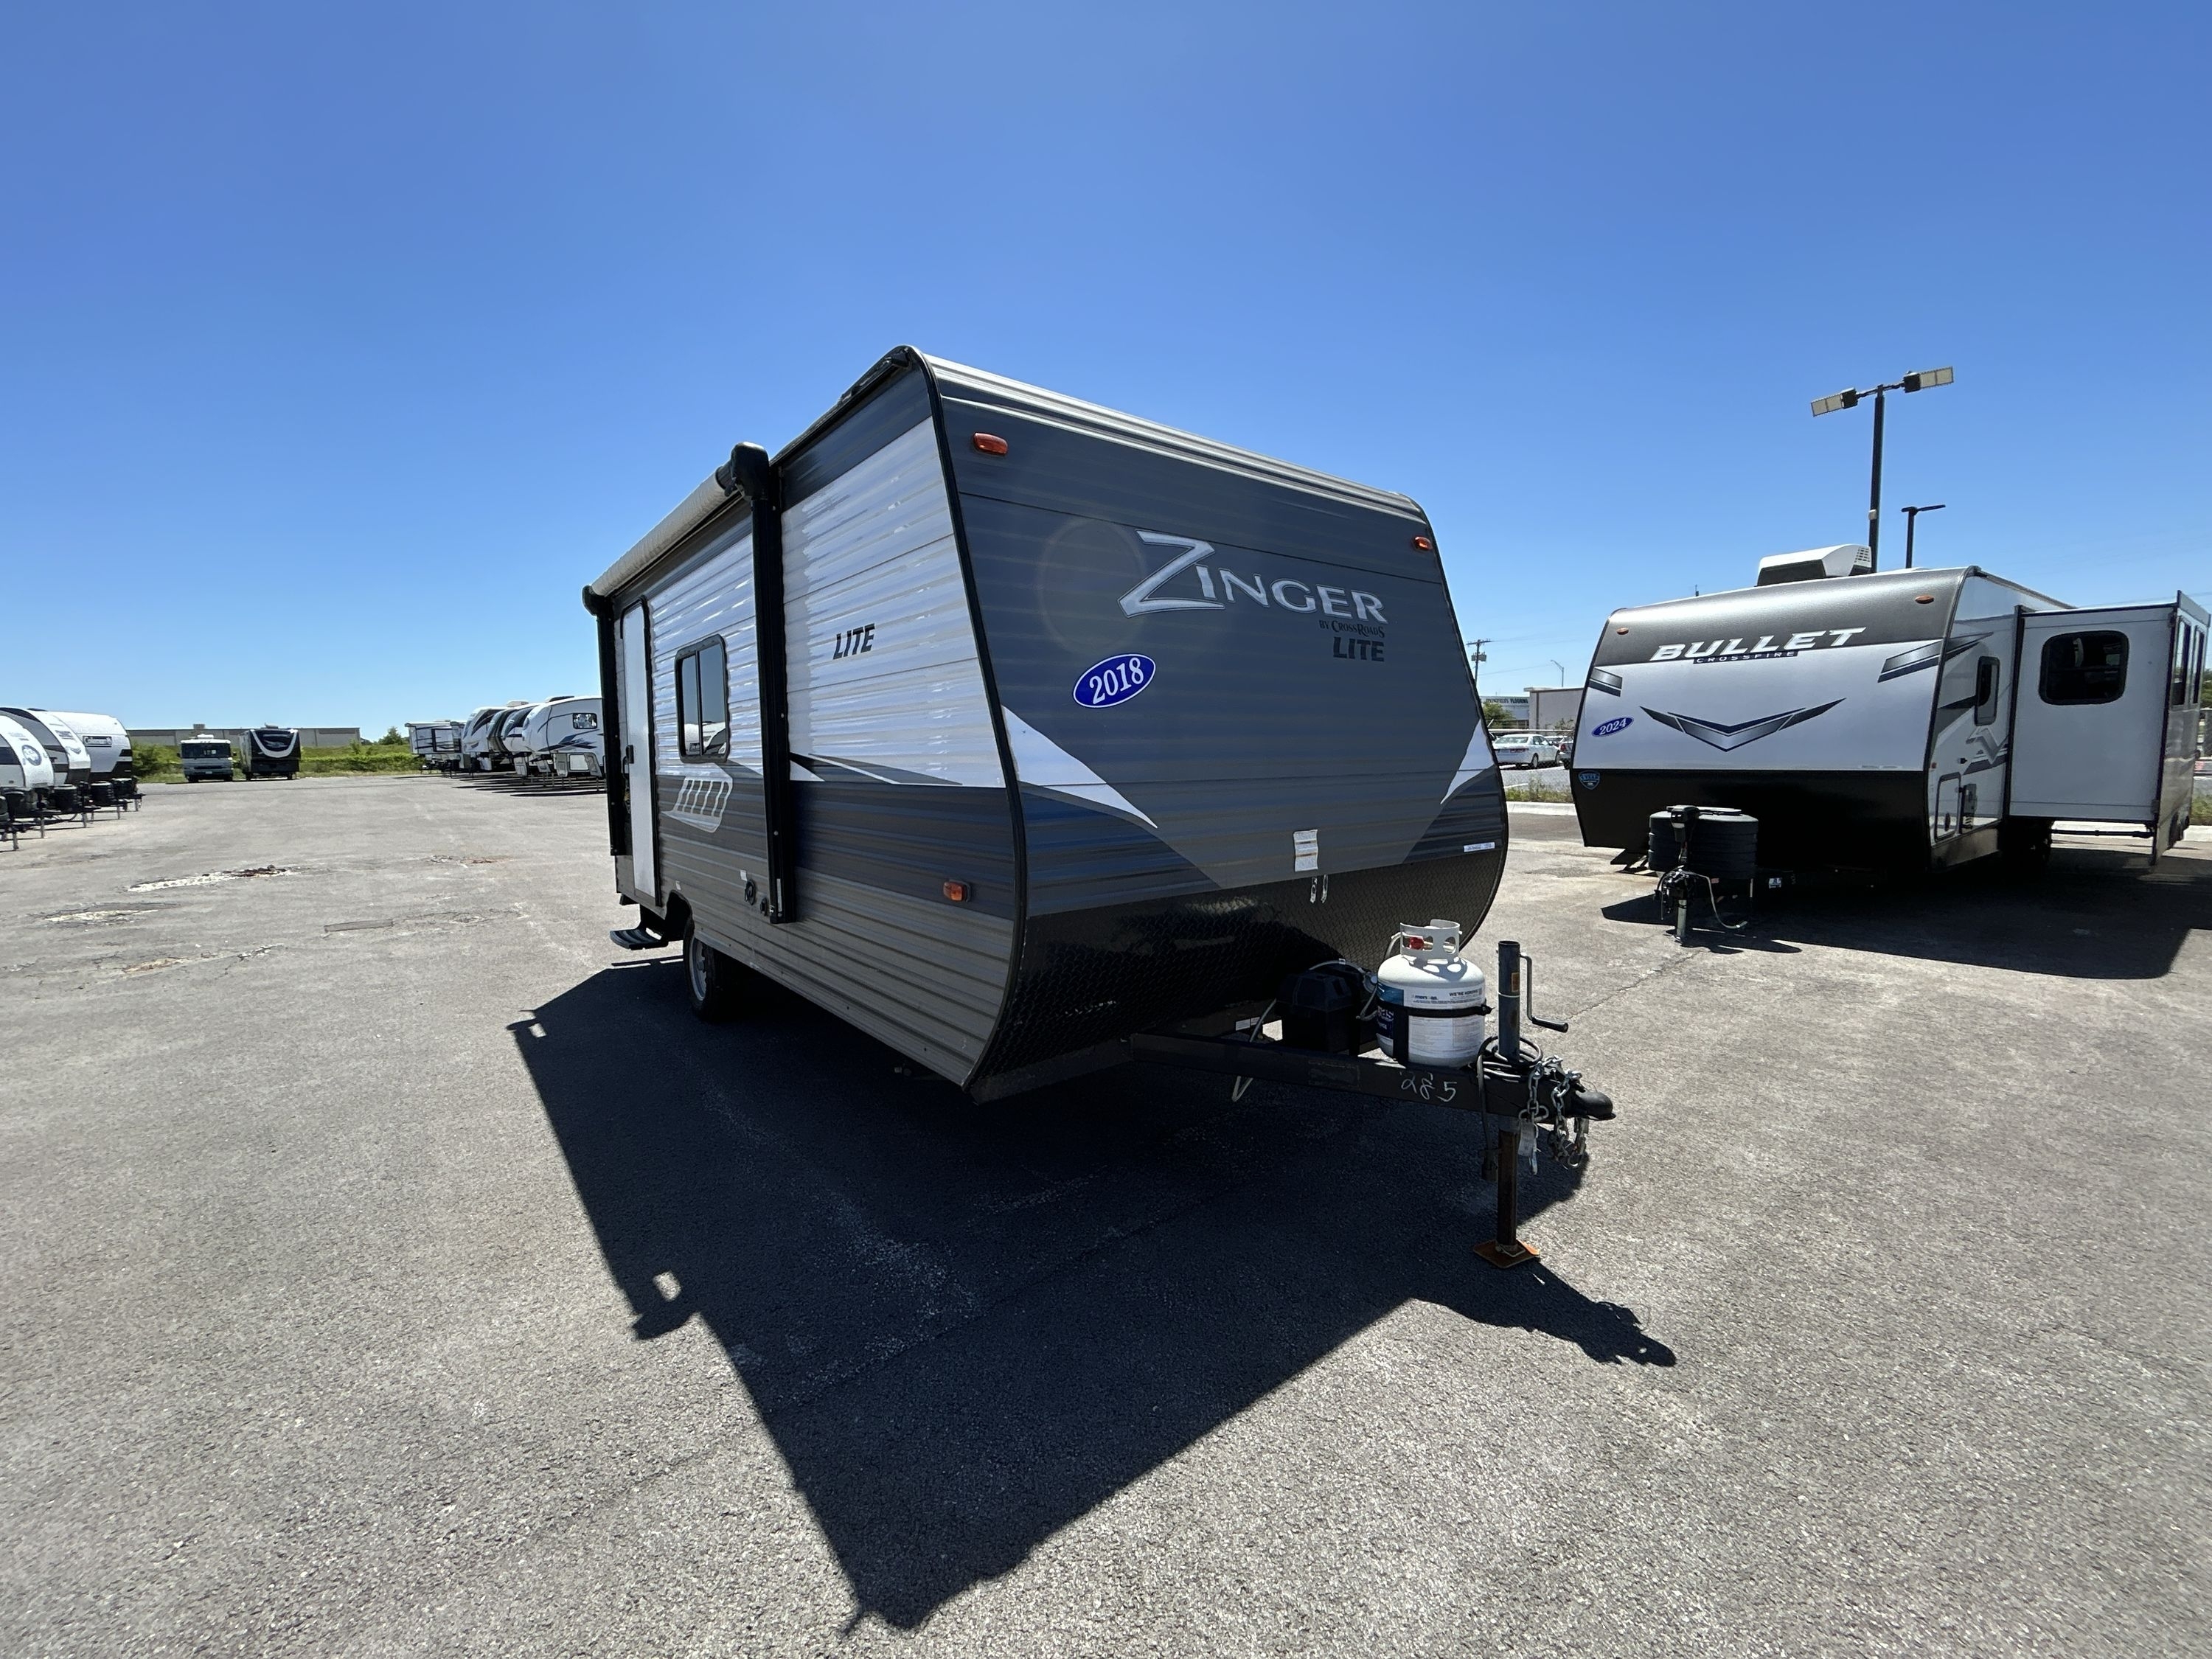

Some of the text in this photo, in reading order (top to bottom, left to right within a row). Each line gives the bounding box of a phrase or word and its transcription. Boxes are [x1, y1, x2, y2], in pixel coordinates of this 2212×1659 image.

[1117, 529, 1388, 624] ZINGER
[1319, 620, 1329, 630] BY
[832, 623, 875, 660] LITE
[1333, 636, 1385, 662] LITE
[1649, 627, 1867, 661] BULLET
[1696, 651, 1794, 664] CROSSFIRE
[1089, 657, 1144, 705] 2018
[1599, 717, 1627, 735] 2024
